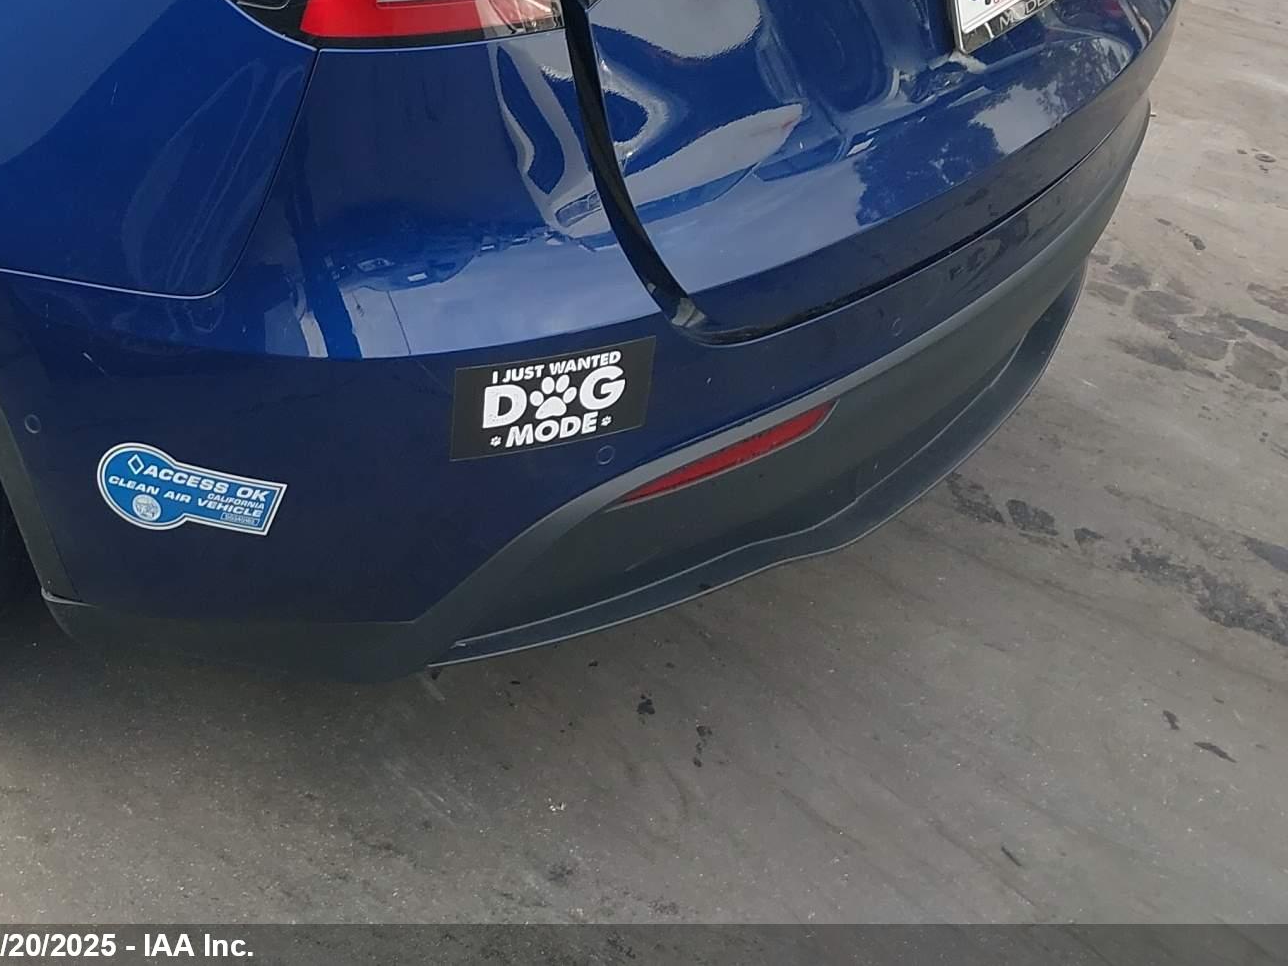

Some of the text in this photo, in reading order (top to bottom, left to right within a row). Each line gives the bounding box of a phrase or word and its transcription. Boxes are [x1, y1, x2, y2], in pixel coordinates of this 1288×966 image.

[492, 350, 622, 384] I JUST WANTED
[505, 411, 599, 448] MODE
[108, 475, 264, 518] CLEAN AIR VEHICLE
[143, 465, 271, 502] ACCESS OK
[207, 493, 265, 510] CALIFORNIA
